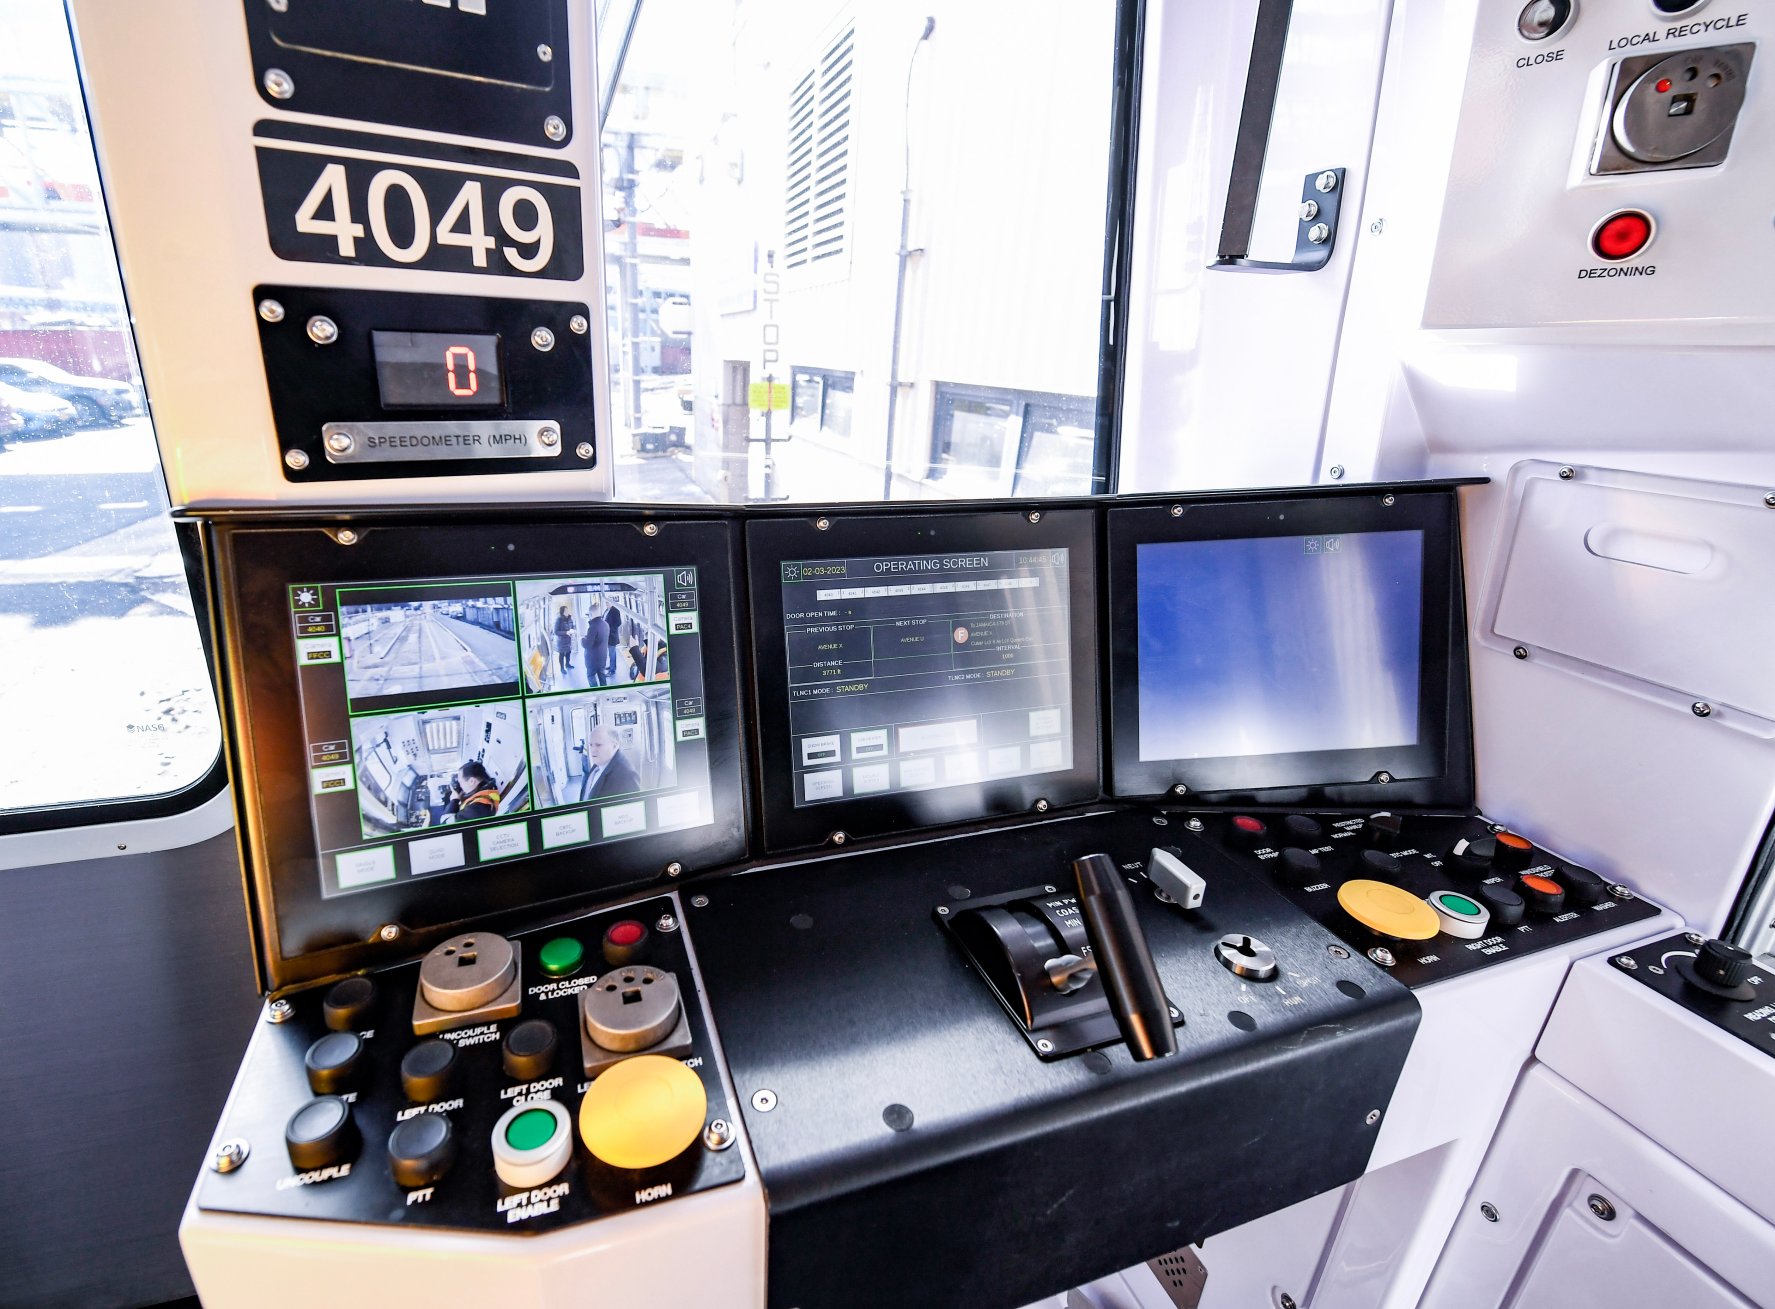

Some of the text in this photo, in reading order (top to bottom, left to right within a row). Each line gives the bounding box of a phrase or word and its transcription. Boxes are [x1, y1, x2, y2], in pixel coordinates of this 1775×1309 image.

[1608, 13, 1749, 51] LOCAL RECYCLE
[1515, 49, 1566, 69] CLOSE
[294, 163, 555, 274] 4049
[1577, 265, 1657, 280] DEZONING
[762, 271, 780, 370] STOP
[445, 344, 478, 398] 0
[366, 431, 529, 449] SPEEDOMETER (MPH)
[803, 566, 846, 576] 02-03-2023
[873, 557, 989, 573] OPERATING SCREEN
[786, 612, 805, 620] DOOR
[806, 611, 823, 619] OPEN
[989, 611, 1024, 620] DESTINATION
[807, 624, 855, 634] PREVIOUS STOP
[958, 630, 965, 641] F
[996, 644, 1021, 652] INTERVAL
[813, 660, 843, 668] DISTANCE
[986, 669, 1016, 679] STANDBY
[836, 683, 869, 693] STANDBY
[1122, 861, 1144, 871] NEUT
[1046, 897, 1077, 909] MIN PW
[1055, 906, 1081, 917] COAS
[1064, 917, 1082, 928] MIN
[1518, 925, 1534, 934] PTT
[1465, 936, 1506, 952] RIGHT DOOR
[1480, 942, 1510, 956] ENABLE
[1417, 953, 1441, 965] HORN
[528, 981, 558, 995] DOOR
[558, 975, 598, 989] CLOSED
[539, 985, 588, 1000] & LOCKED
[1282, 995, 1304, 1007] RUN
[457, 1031, 500, 1048] SWITCH
[500, 1076, 564, 1100] LEFT DOOR
[512, 1089, 552, 1107] CLOSE
[396, 1105, 428, 1122] LEFT
[275, 1162, 352, 1191] UNCOUPLE
[406, 1186, 435, 1206] PTT
[496, 1182, 570, 1213] LEFT DOOR
[634, 1182, 673, 1204] HORN
[506, 1197, 561, 1224] ENABLE
